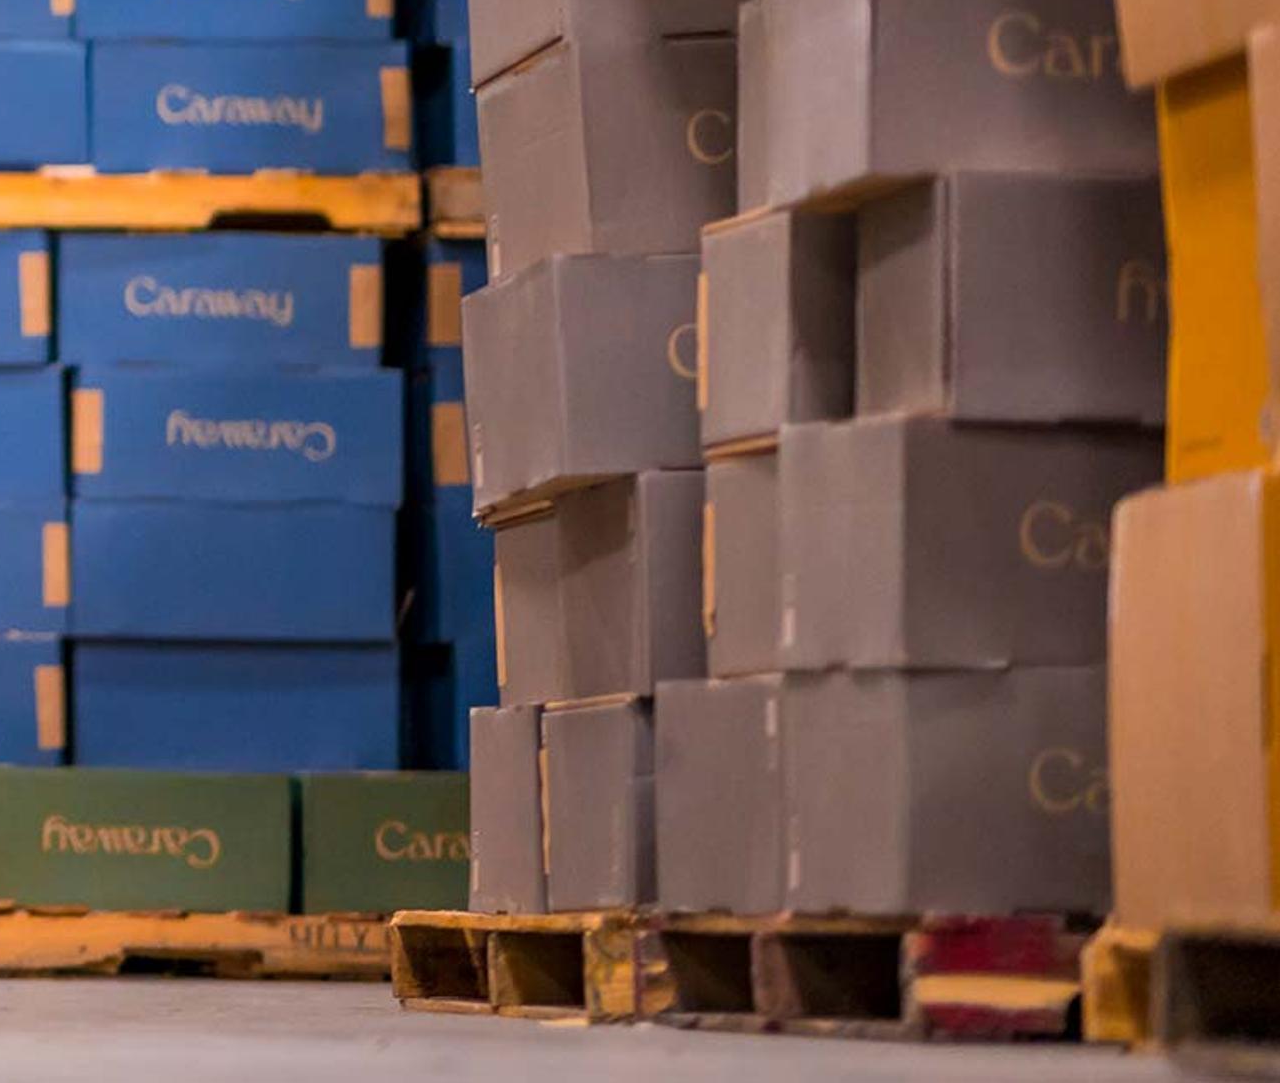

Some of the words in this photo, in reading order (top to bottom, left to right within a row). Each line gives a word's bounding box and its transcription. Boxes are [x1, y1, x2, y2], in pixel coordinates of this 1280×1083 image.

[155, 83, 324, 133] Caraway
[123, 274, 295, 327] Caraway
[165, 408, 337, 462] Caraway
[40, 813, 221, 869] Caraway
